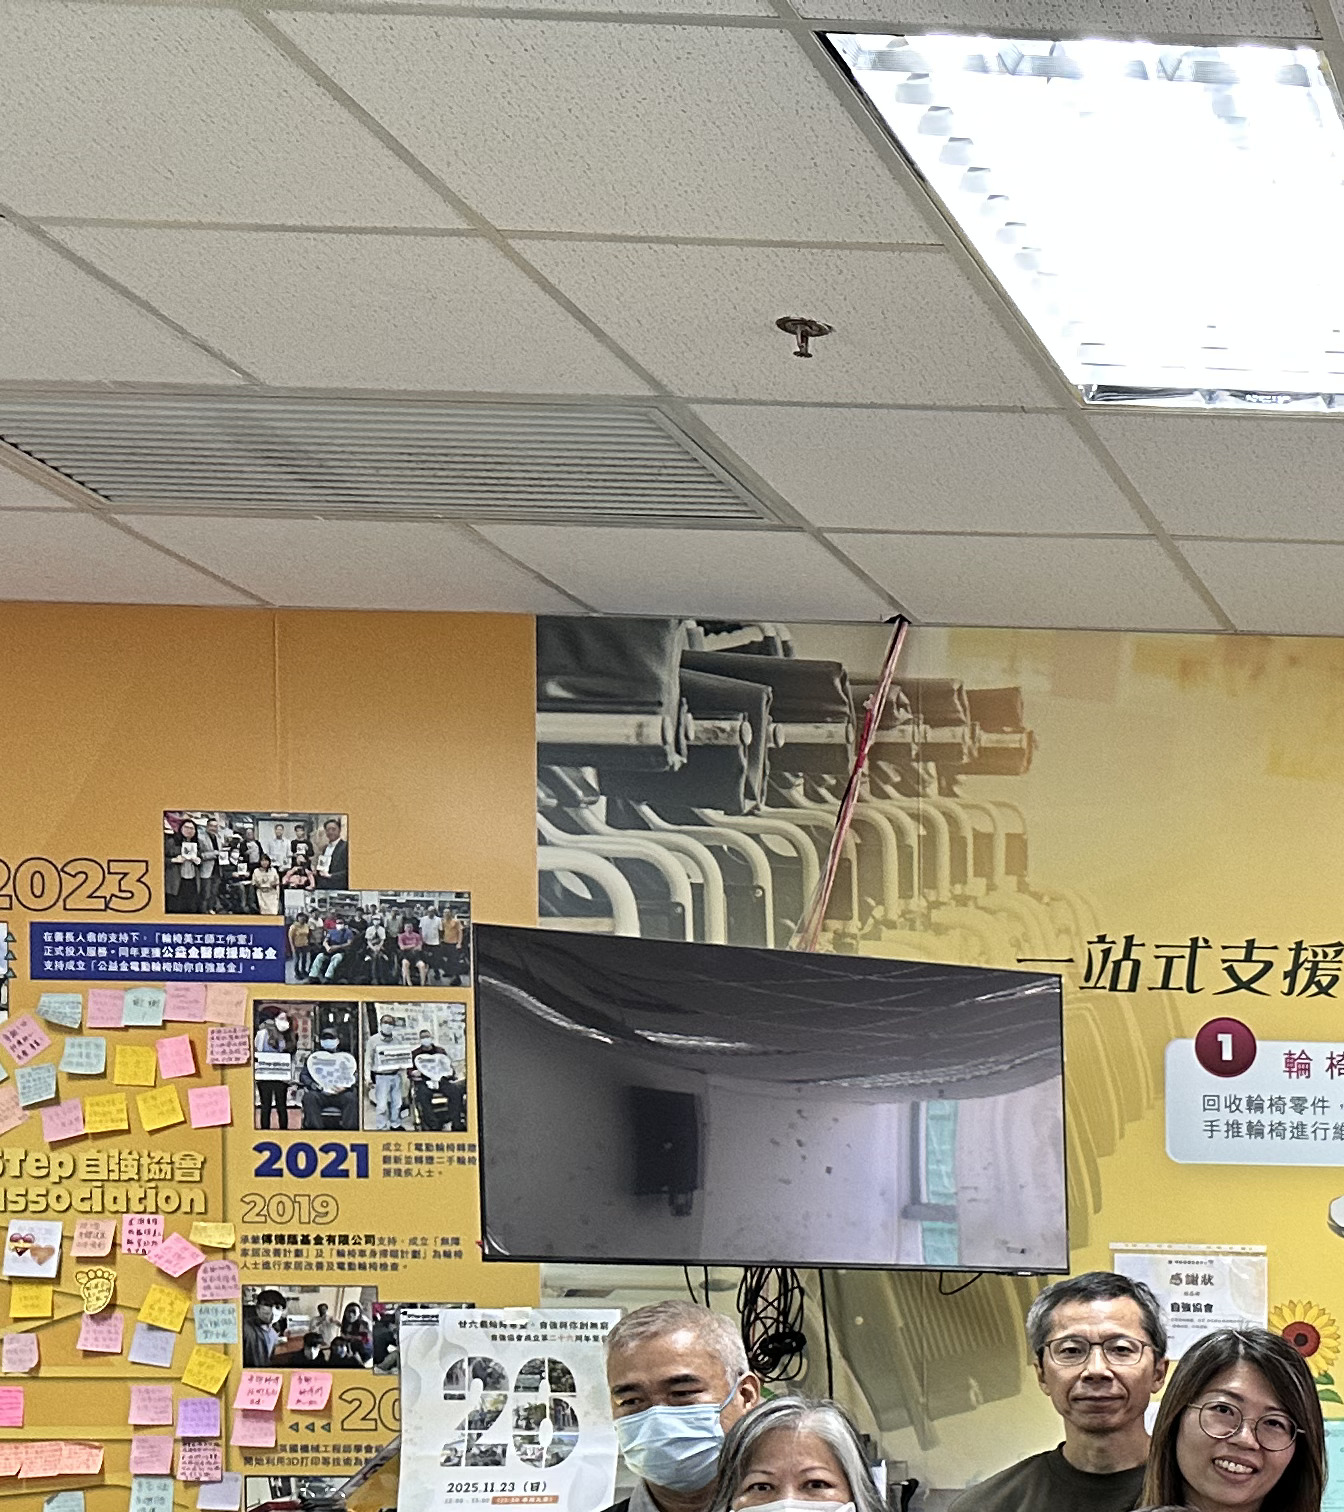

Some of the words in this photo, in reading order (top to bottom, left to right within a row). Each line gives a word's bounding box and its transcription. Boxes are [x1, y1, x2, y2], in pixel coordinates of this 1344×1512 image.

[0, 857, 151, 912] 023
[1217, 1034, 1232, 1061] 1
[79, 1149, 206, 1183] 自強協會
[253, 1141, 369, 1179] 2021
[0, 1183, 208, 1214] ssociation
[241, 1193, 339, 1225] 2019
